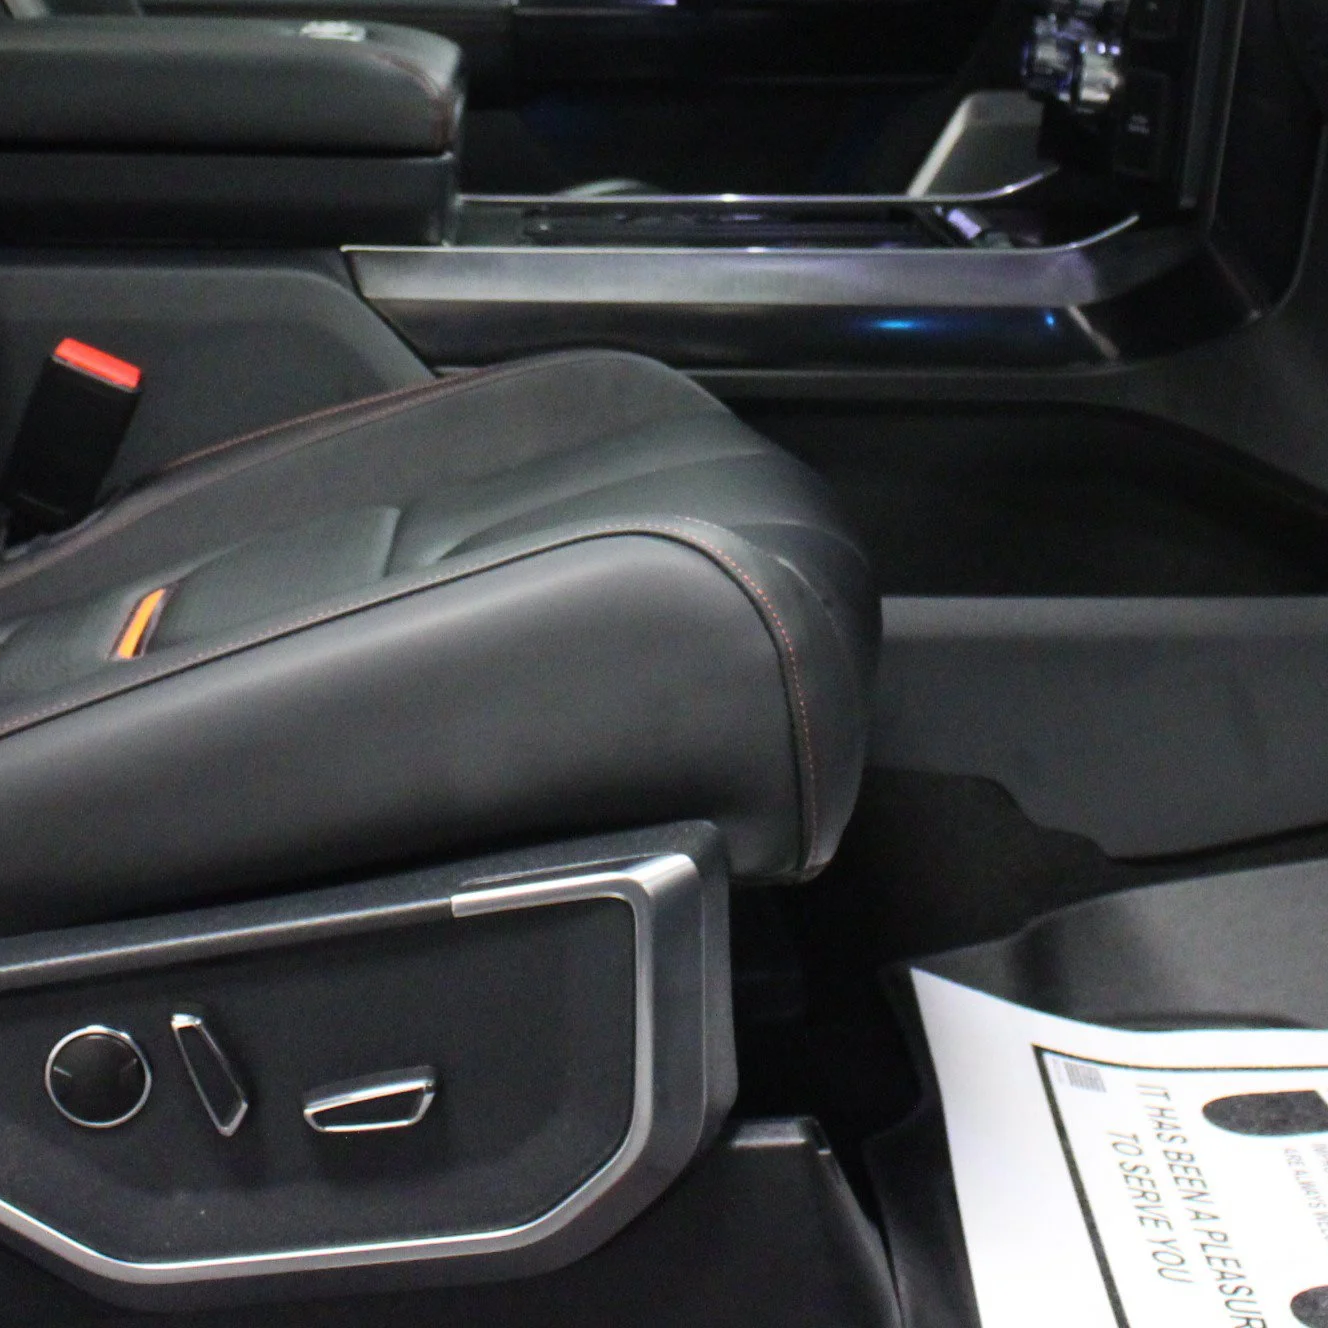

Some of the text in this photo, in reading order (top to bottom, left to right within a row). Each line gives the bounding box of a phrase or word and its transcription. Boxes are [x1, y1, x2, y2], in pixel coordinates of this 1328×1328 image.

[1135, 1082, 1172, 1102] IT
[1144, 1104, 1188, 1144] HAS
[1162, 1147, 1215, 1205] BEEN
[1294, 1169, 1328, 1209] ALWAYS
[1105, 1130, 1196, 1284] TO SERVE YOU
[1184, 1207, 1222, 1221] A
